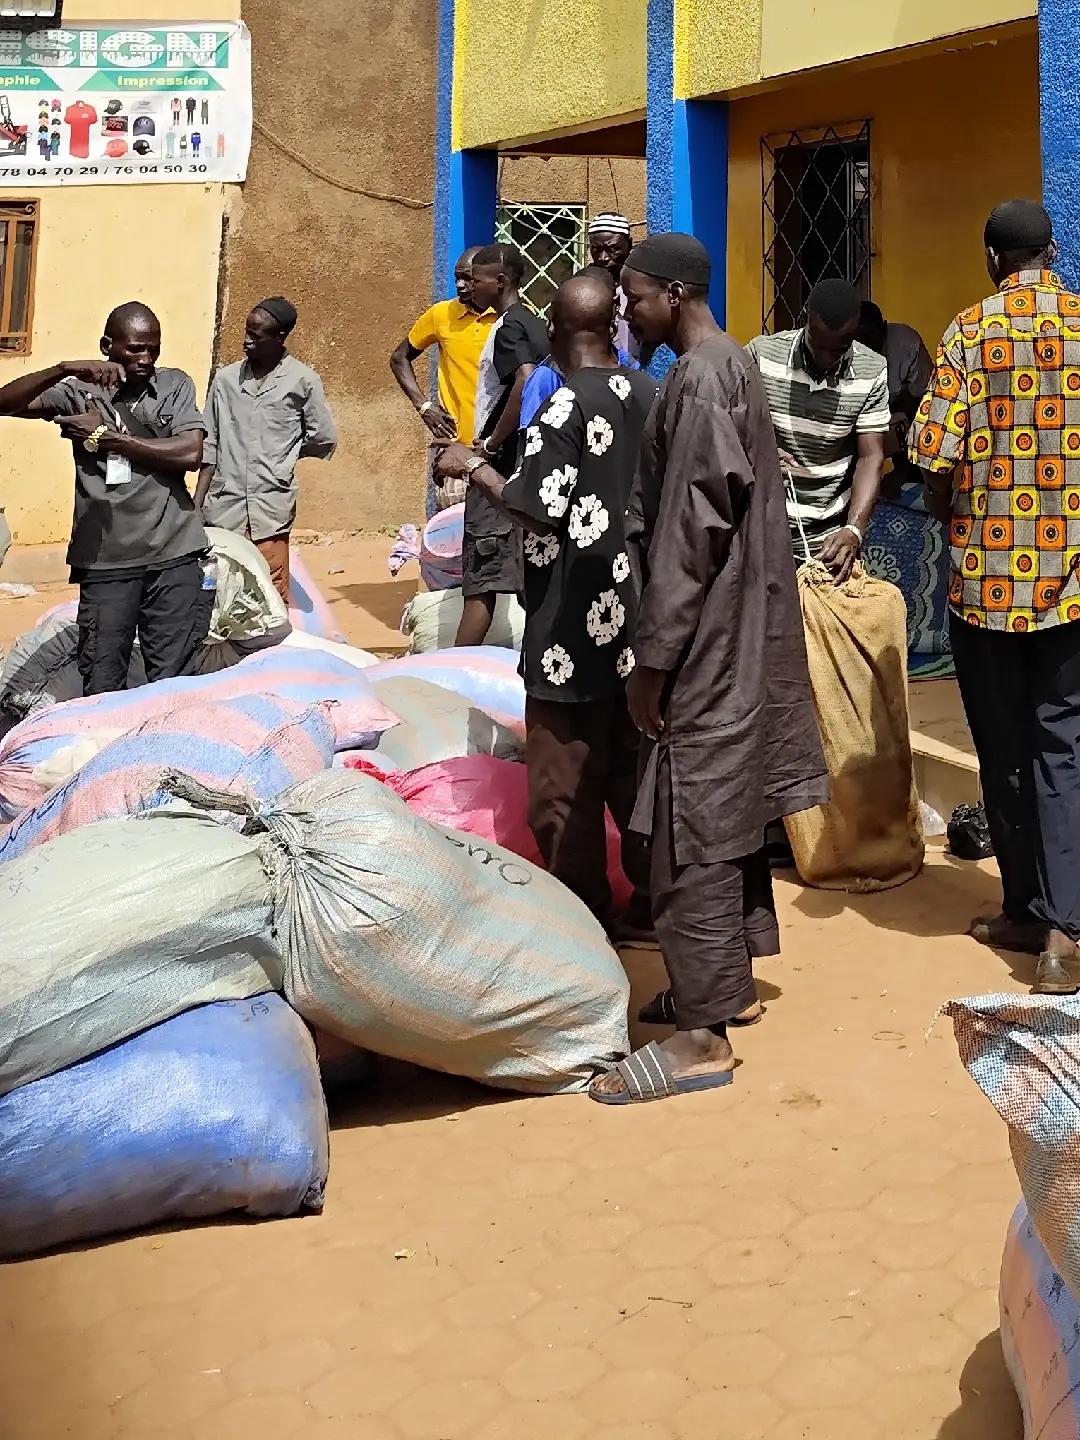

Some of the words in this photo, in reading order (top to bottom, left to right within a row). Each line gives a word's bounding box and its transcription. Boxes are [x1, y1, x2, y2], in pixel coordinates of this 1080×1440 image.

[118, 75, 209, 87] Impression
[27, 167, 47, 176] 04
[54, 166, 73, 176] 70
[80, 166, 99, 176] 29
[113, 165, 134, 175] 76
[139, 164, 159, 175] 04
[164, 164, 183, 174] 50
[188, 164, 207, 174] 30
